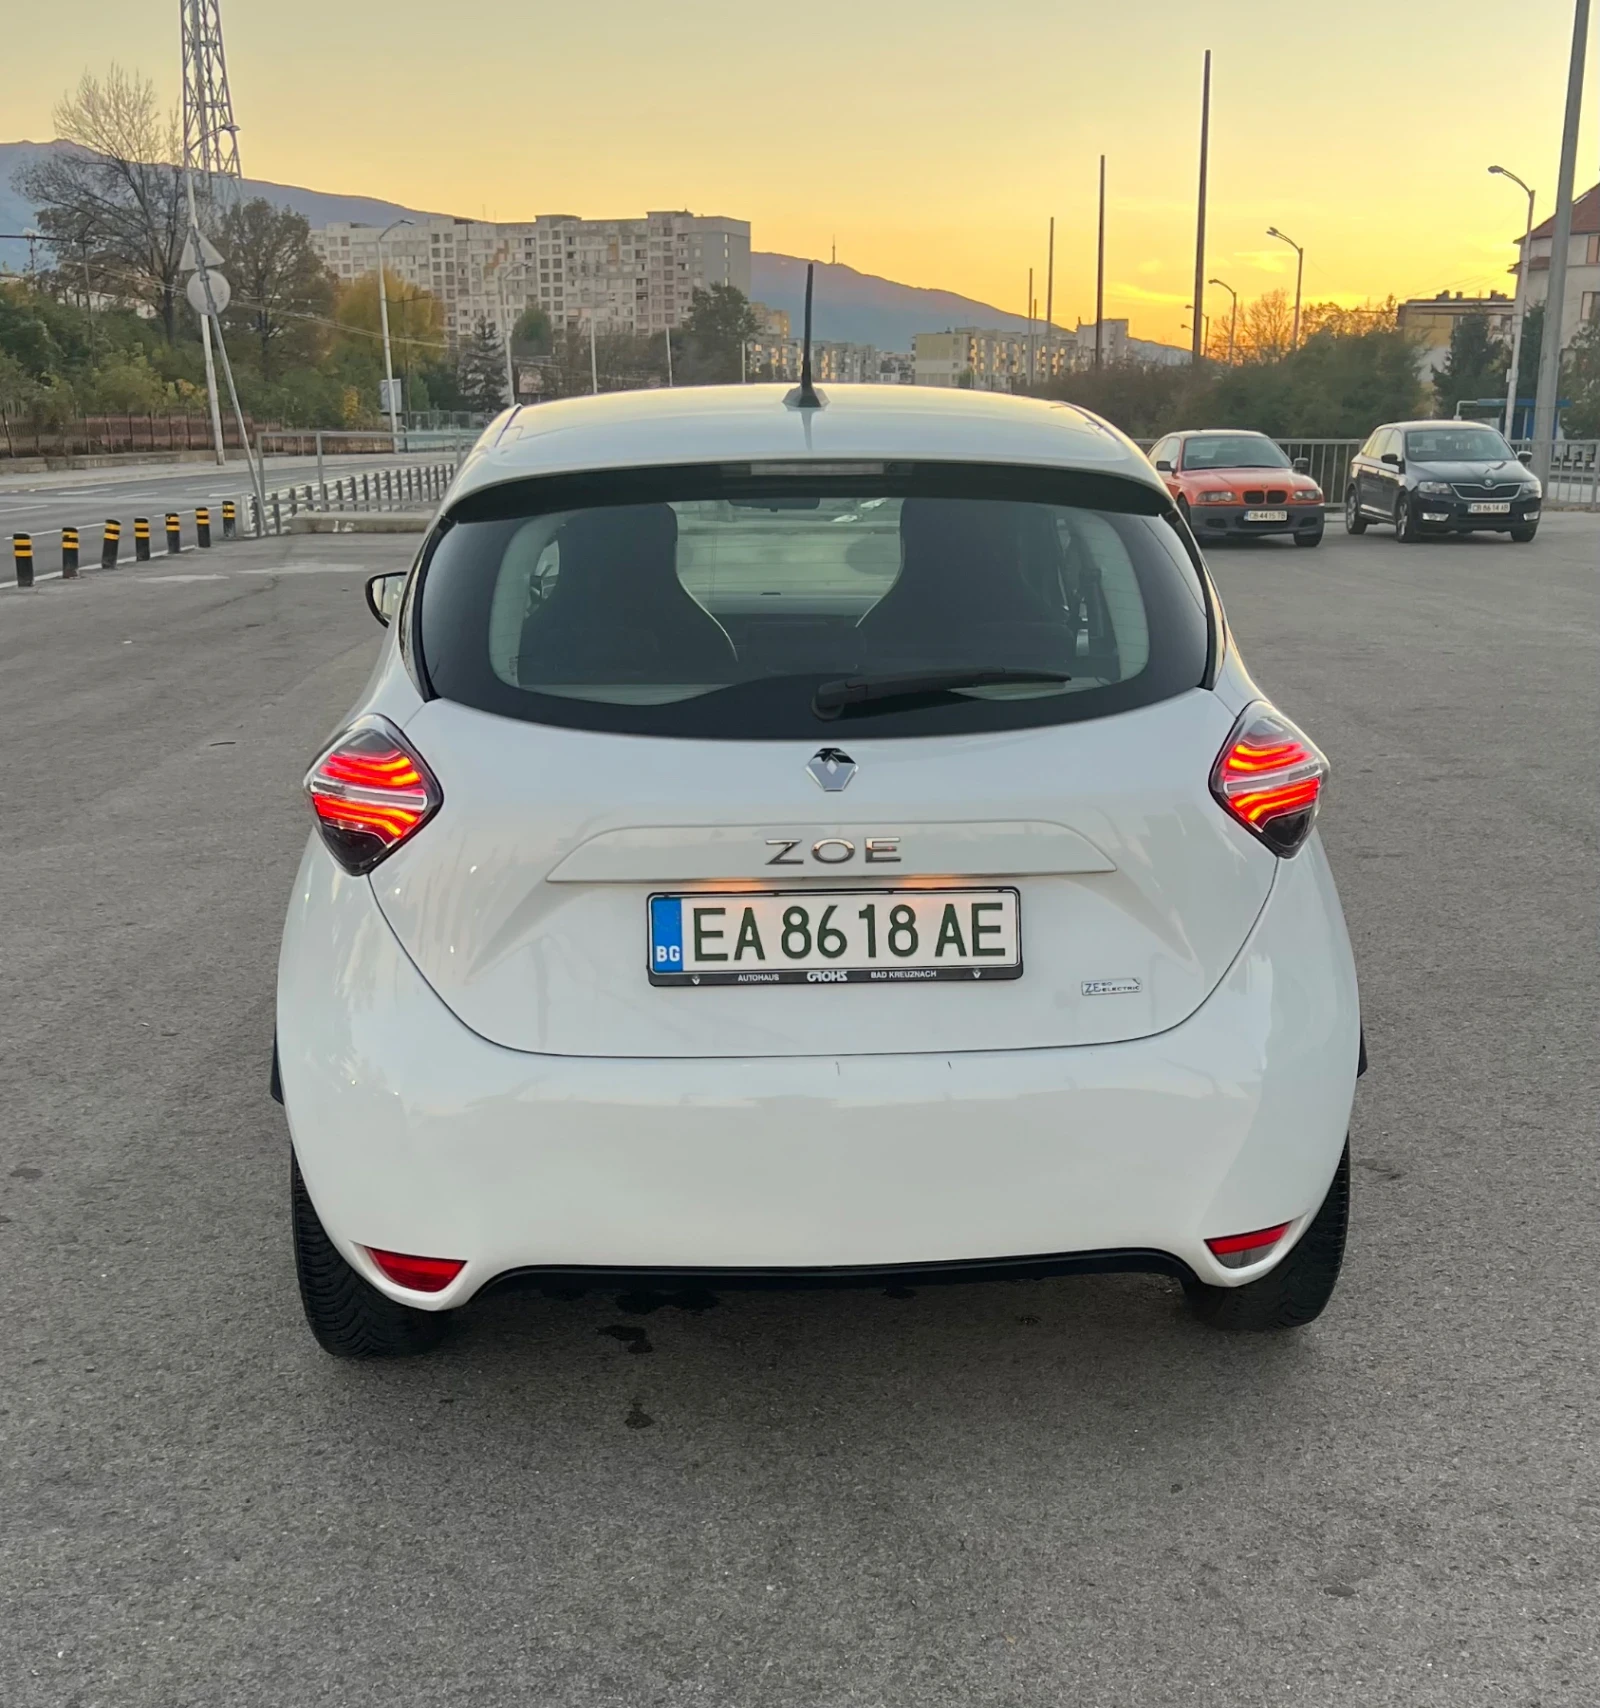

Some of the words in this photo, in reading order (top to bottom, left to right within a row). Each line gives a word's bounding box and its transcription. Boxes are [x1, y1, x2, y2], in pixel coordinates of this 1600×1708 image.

[765, 837, 901, 865] ZOE
[693, 907, 766, 962] EA
[780, 904, 918, 959] 8618
[935, 902, 1006, 958] AE
[656, 945, 680, 962] BG
[737, 973, 779, 982] AUTOHAUS
[807, 970, 848, 982] GROHS
[870, 971, 887, 979] BAD
[889, 970, 937, 979] KREUZNACH
